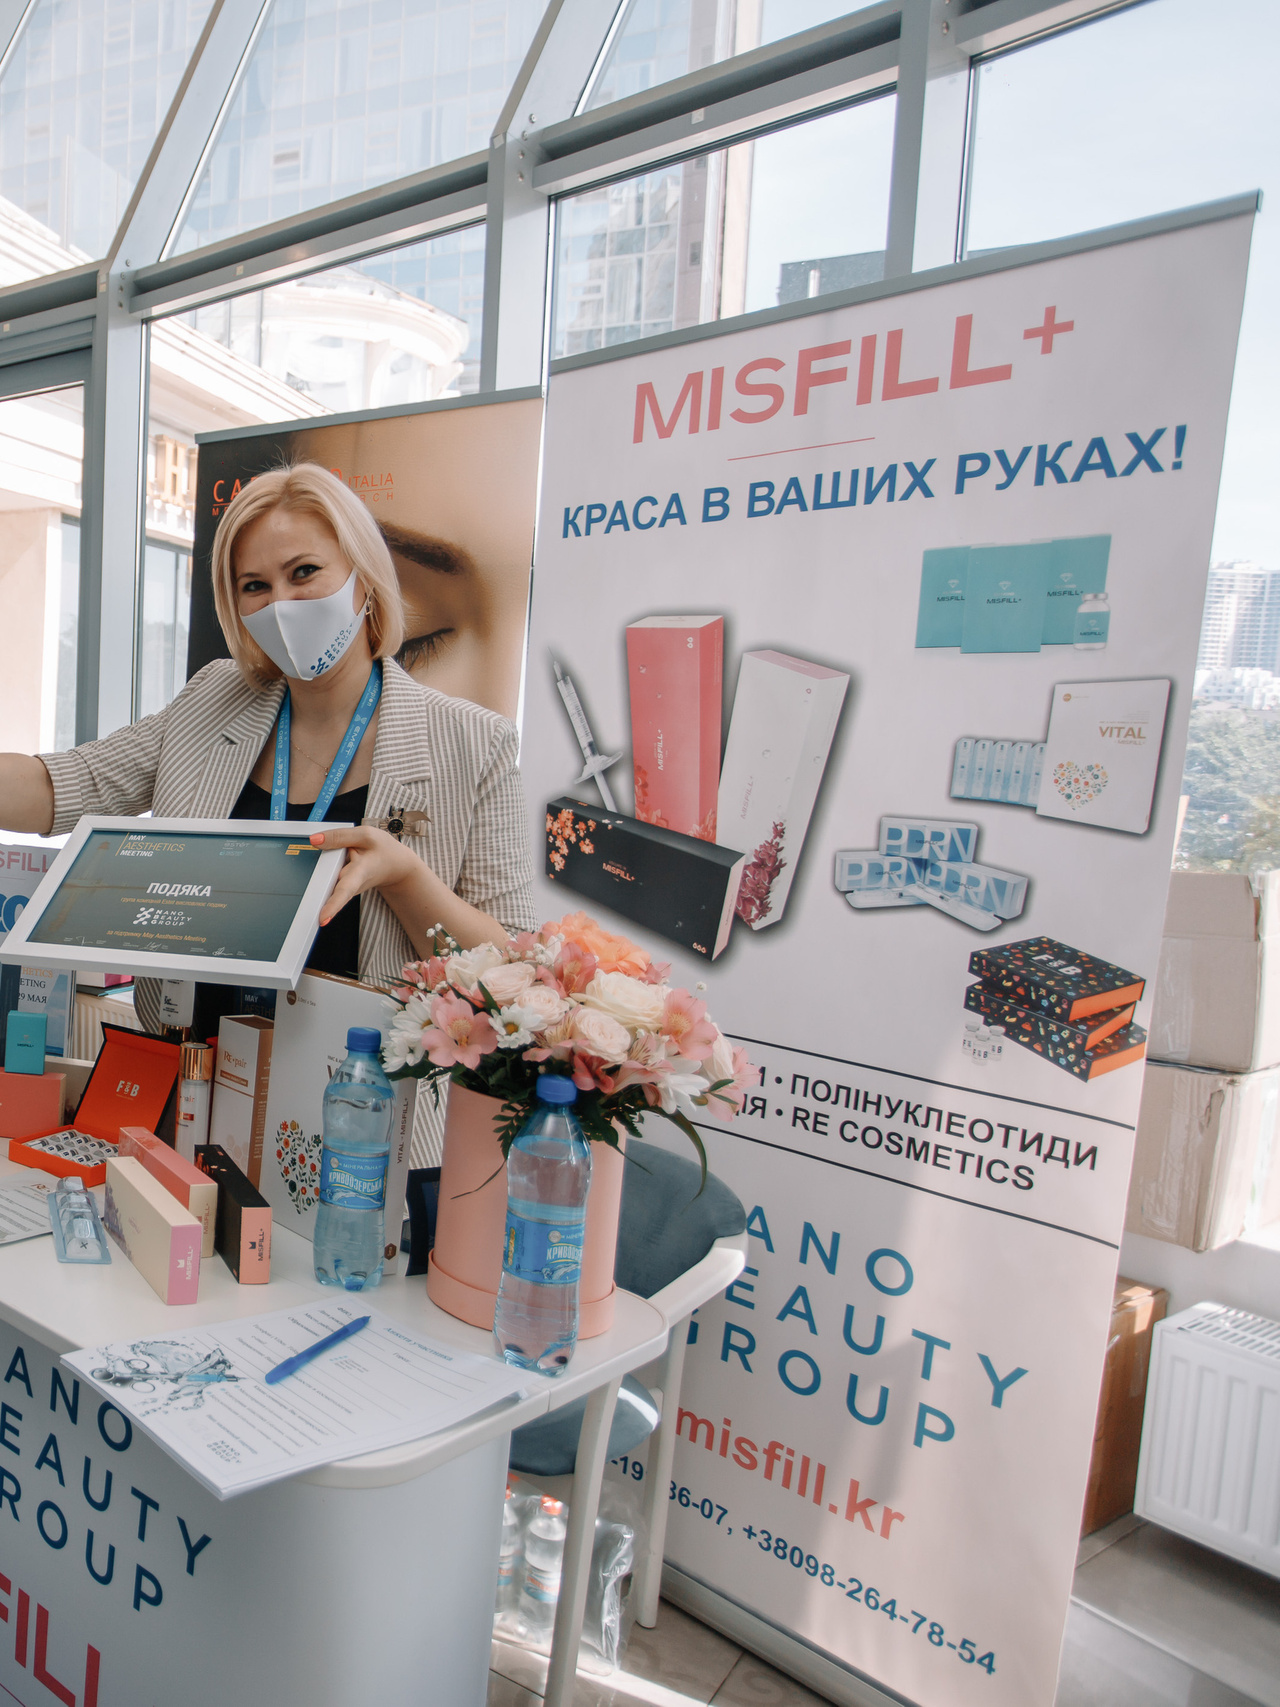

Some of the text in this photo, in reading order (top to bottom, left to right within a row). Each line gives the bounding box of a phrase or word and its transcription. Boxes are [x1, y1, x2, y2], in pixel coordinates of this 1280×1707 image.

[632, 305, 1075, 444] MISFILL+
[348, 473, 394, 489] ITALIA
[561, 425, 1189, 539] КРАСА В ВАШИХ РУКАХ!
[1099, 726, 1146, 739] VITAL
[123, 841, 186, 852] AESTHETICS
[146, 882, 212, 897] ПОДЯКА
[20, 966, 53, 979] HETICS
[19, 977, 46, 989] ETING
[26, 993, 47, 1004] МАЯ
[244, 994, 258, 1003] MAY
[244, 1005, 275, 1018] AESTHE
[789, 1073, 1099, 1171] ПОЛІНУКЛЕОТИДИ
[791, 1107, 1035, 1191] RE COSMETICS
[746, 1205, 914, 1297] ANO
[724, 1266, 1029, 1409] EAUTY
[742, 1523, 997, 1676] +38098-264-78-54
